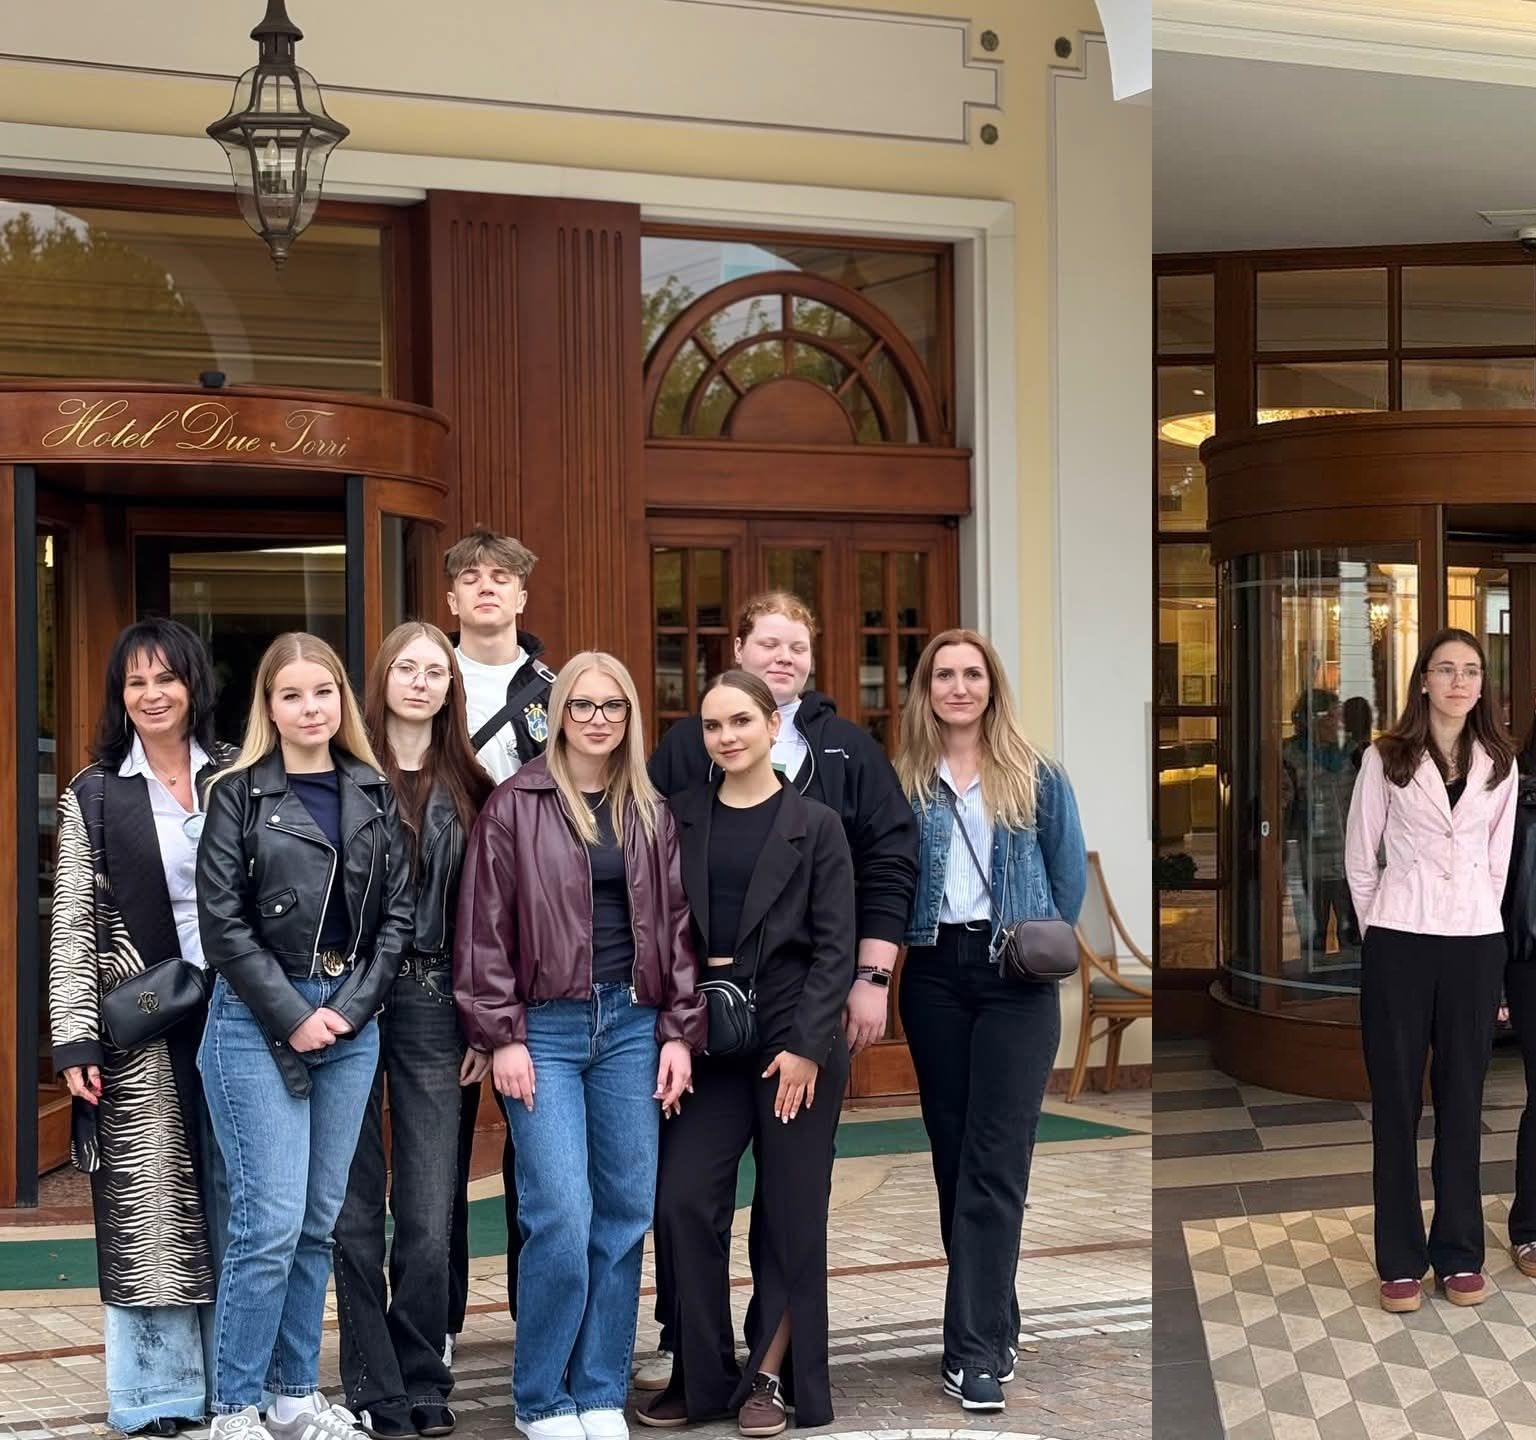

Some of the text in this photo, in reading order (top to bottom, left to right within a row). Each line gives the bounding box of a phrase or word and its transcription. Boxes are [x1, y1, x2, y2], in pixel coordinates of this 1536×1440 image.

[41, 398, 351, 457] Hotel Due Torri
